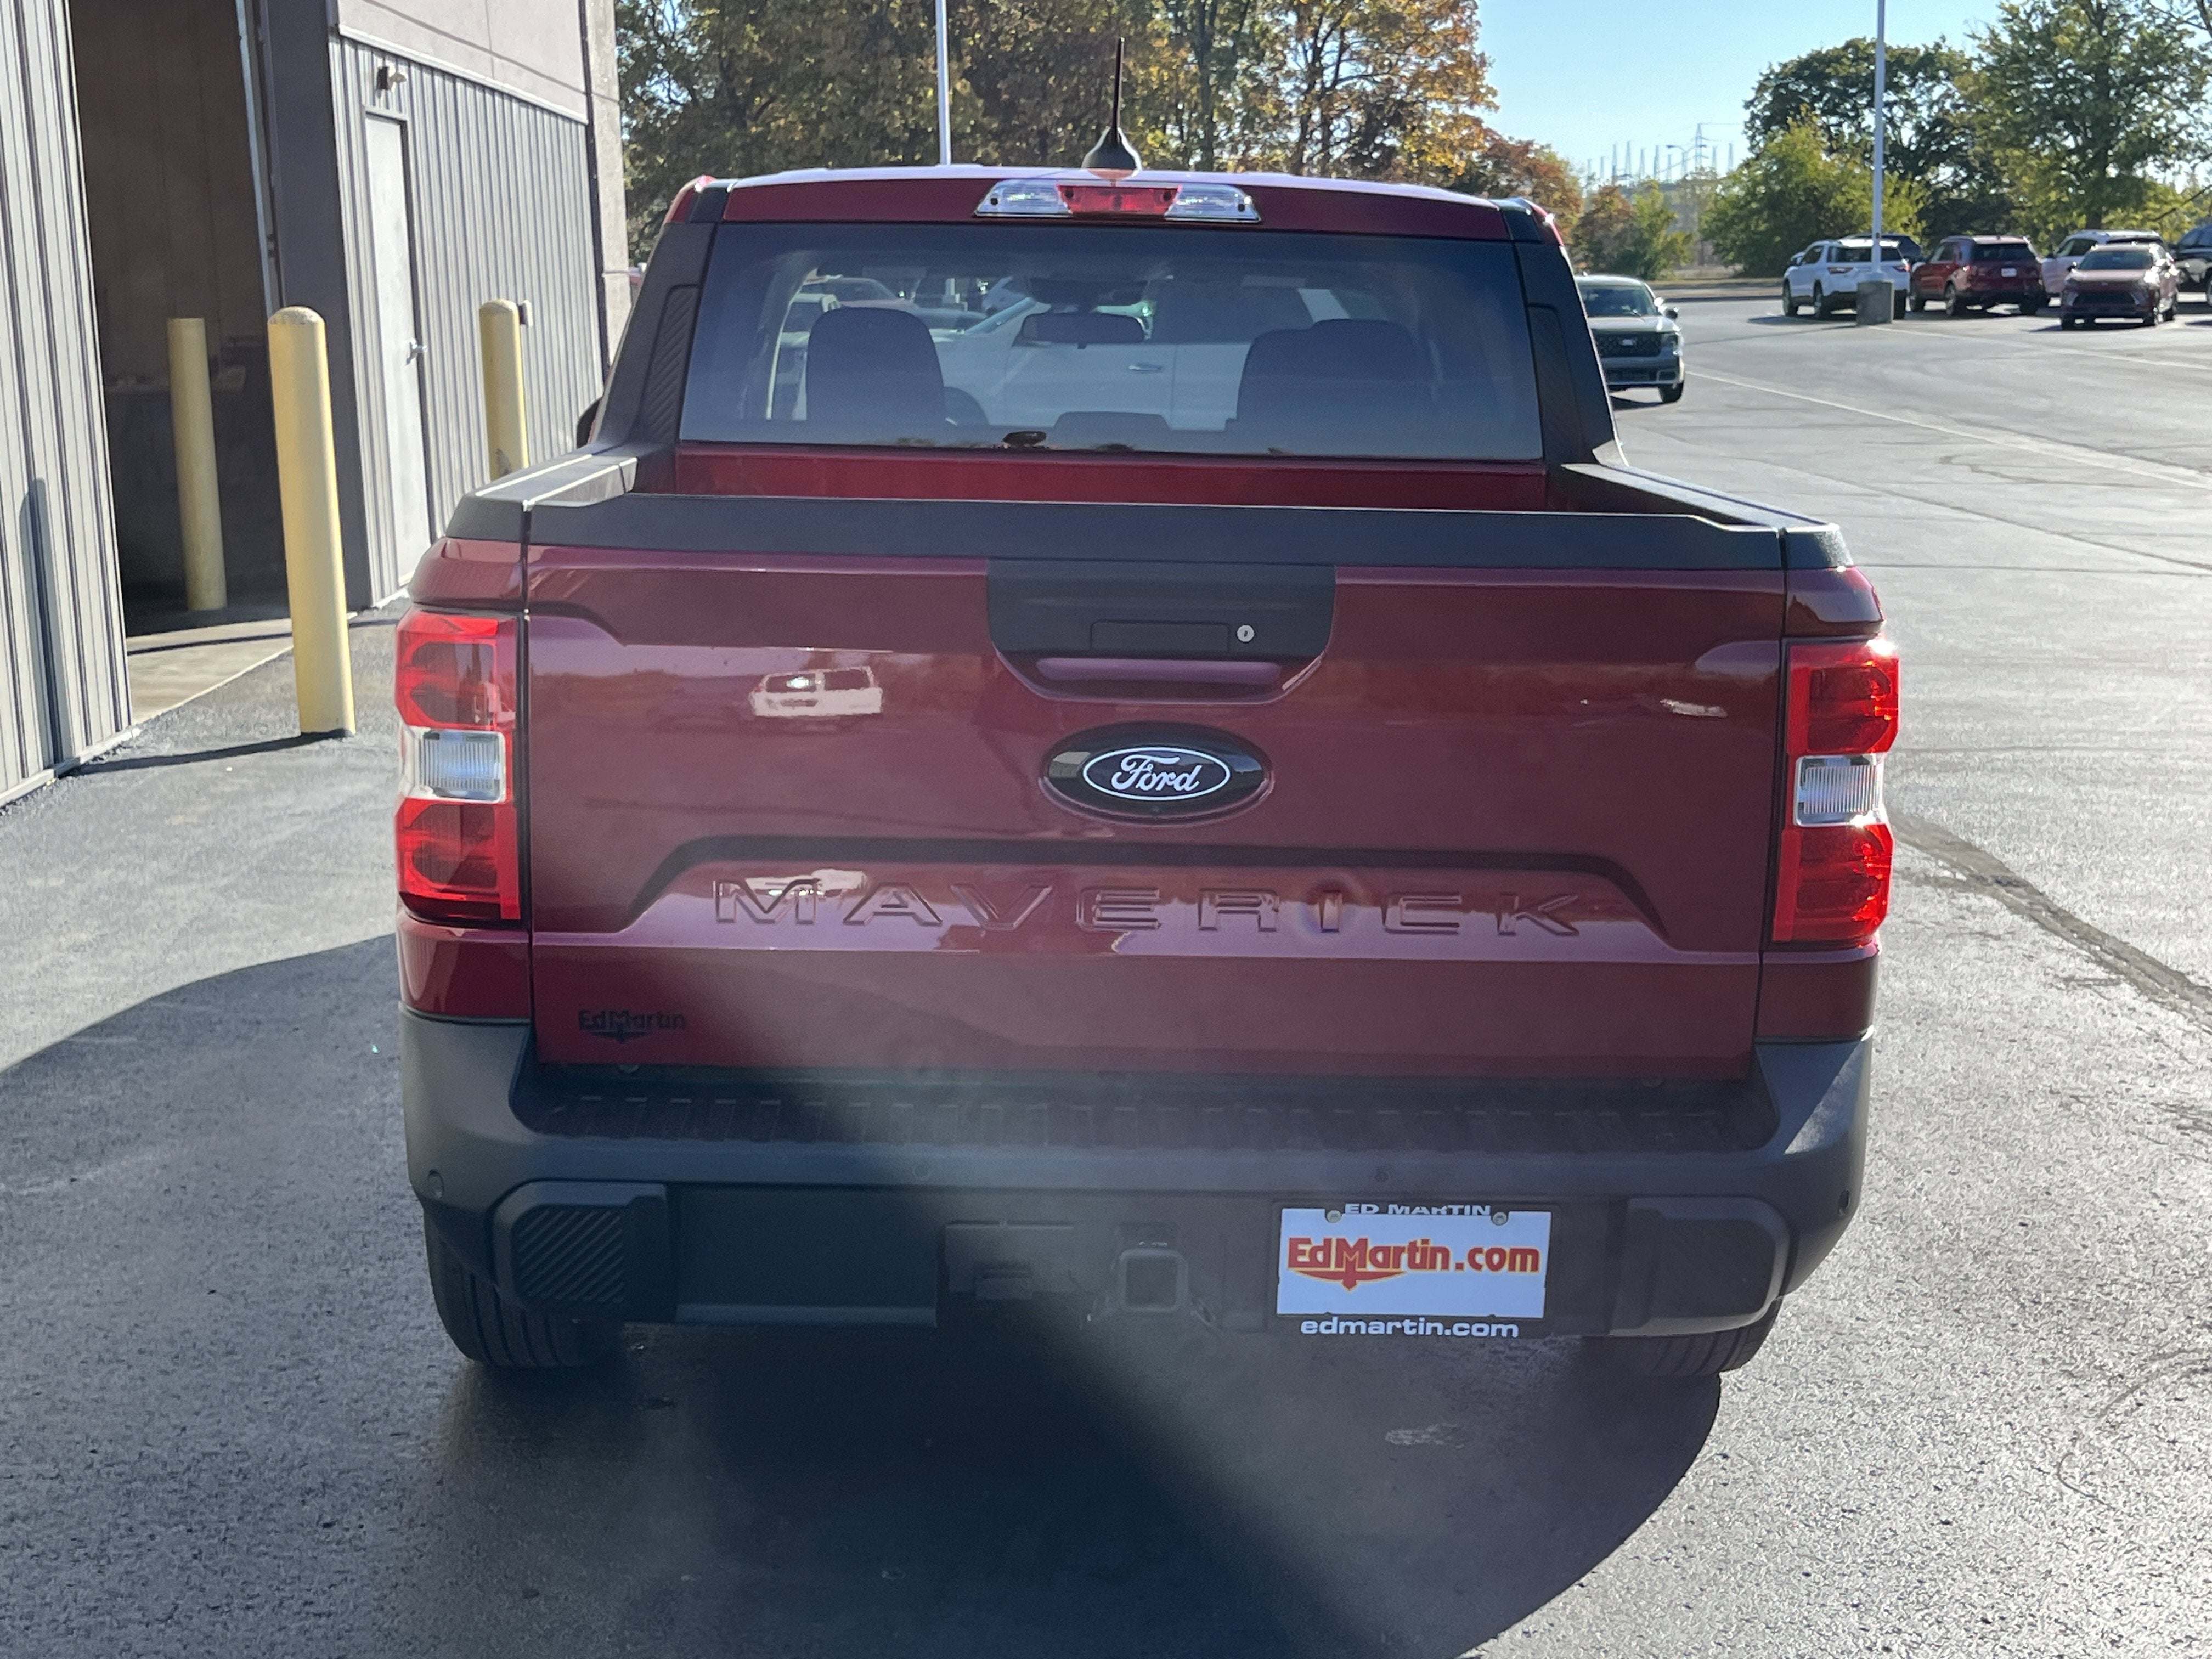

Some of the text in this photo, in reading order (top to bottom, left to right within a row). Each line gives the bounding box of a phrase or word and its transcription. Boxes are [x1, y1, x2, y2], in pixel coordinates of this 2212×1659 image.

[1111, 754, 1203, 792] Ford
[712, 876, 1581, 938] MAVERICK
[579, 1010, 686, 1043] EdMartin
[1345, 1204, 1491, 1216] ED MARTIN
[1287, 1237, 1541, 1291] EdMartin.com
[1300, 1317, 1519, 1338] edmartin.com
